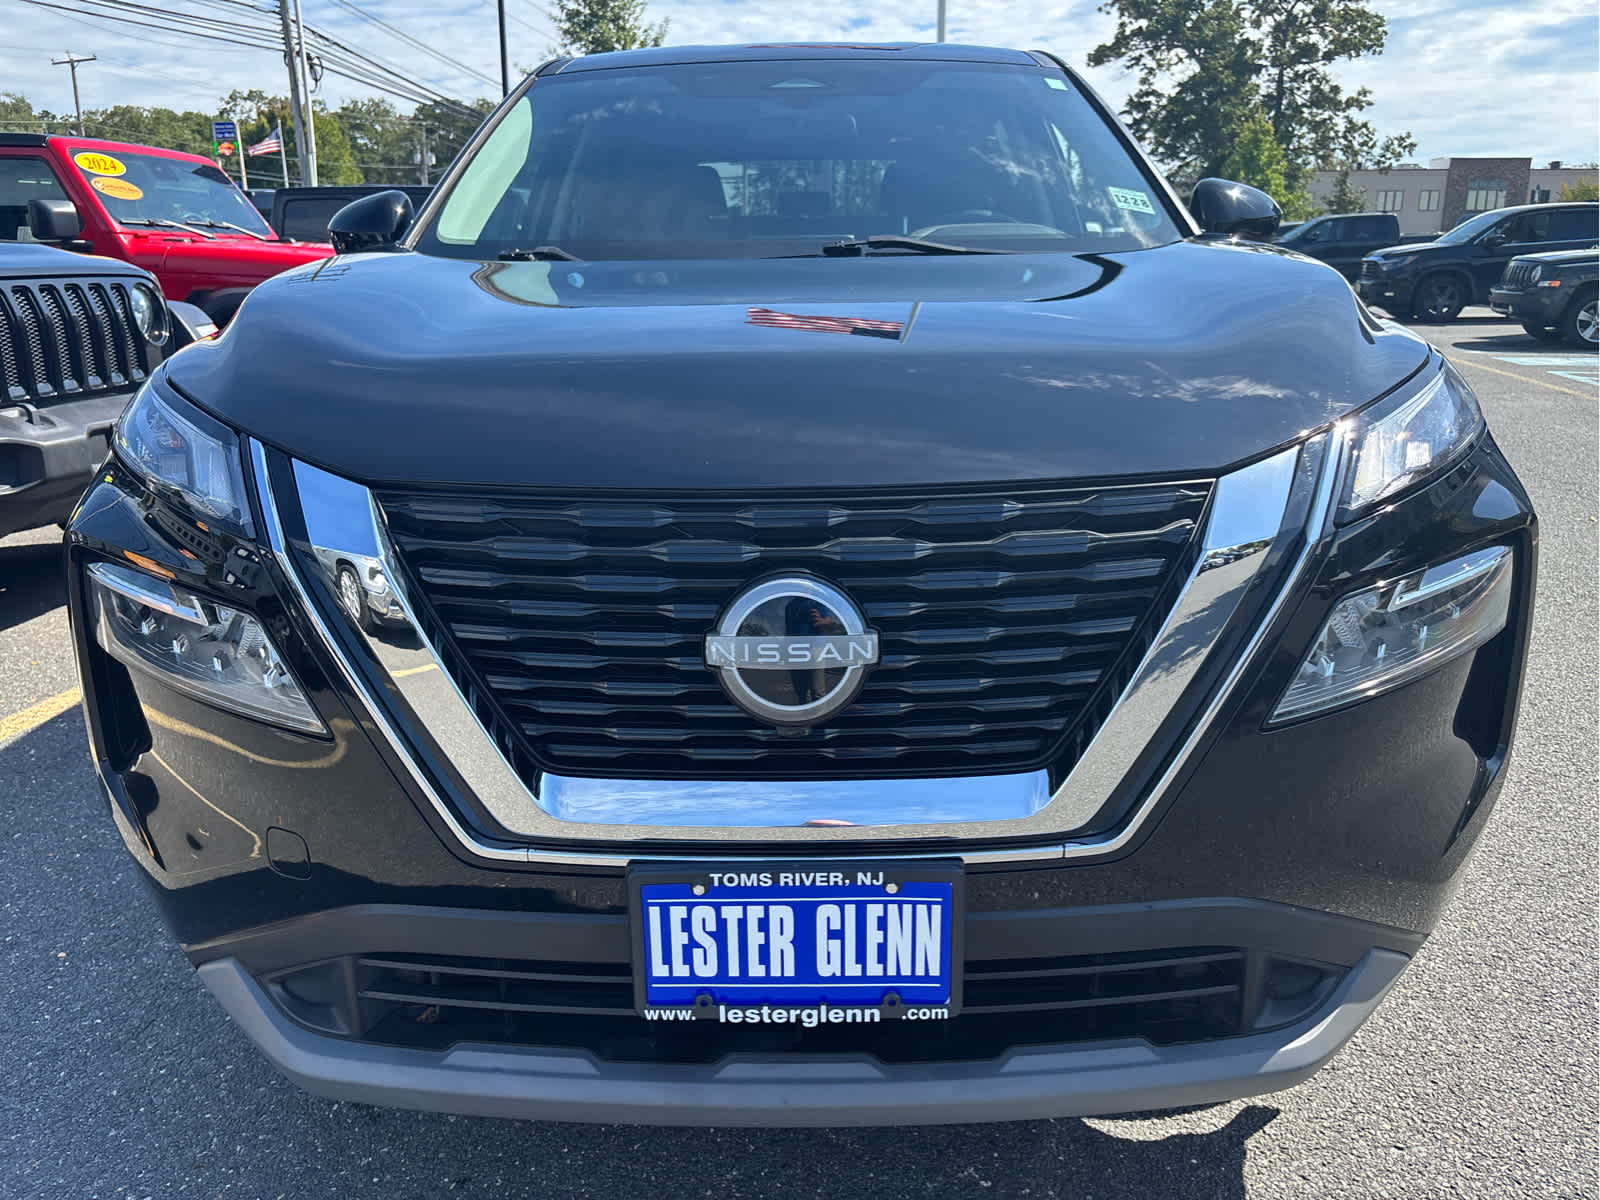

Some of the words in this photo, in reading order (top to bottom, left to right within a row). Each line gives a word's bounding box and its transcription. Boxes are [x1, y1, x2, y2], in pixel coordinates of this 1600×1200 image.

[83, 157, 117, 171] 2024
[710, 639, 873, 662] NISSAN
[709, 872, 772, 887] TOMS
[779, 872, 851, 887] RIVER,
[857, 872, 884, 886] NJ
[648, 905, 795, 977] LESTER
[816, 904, 942, 977] GLENN
[644, 1009, 696, 1021] www.
[719, 1005, 880, 1027] lesterglenn
[901, 1007, 949, 1021] .com
